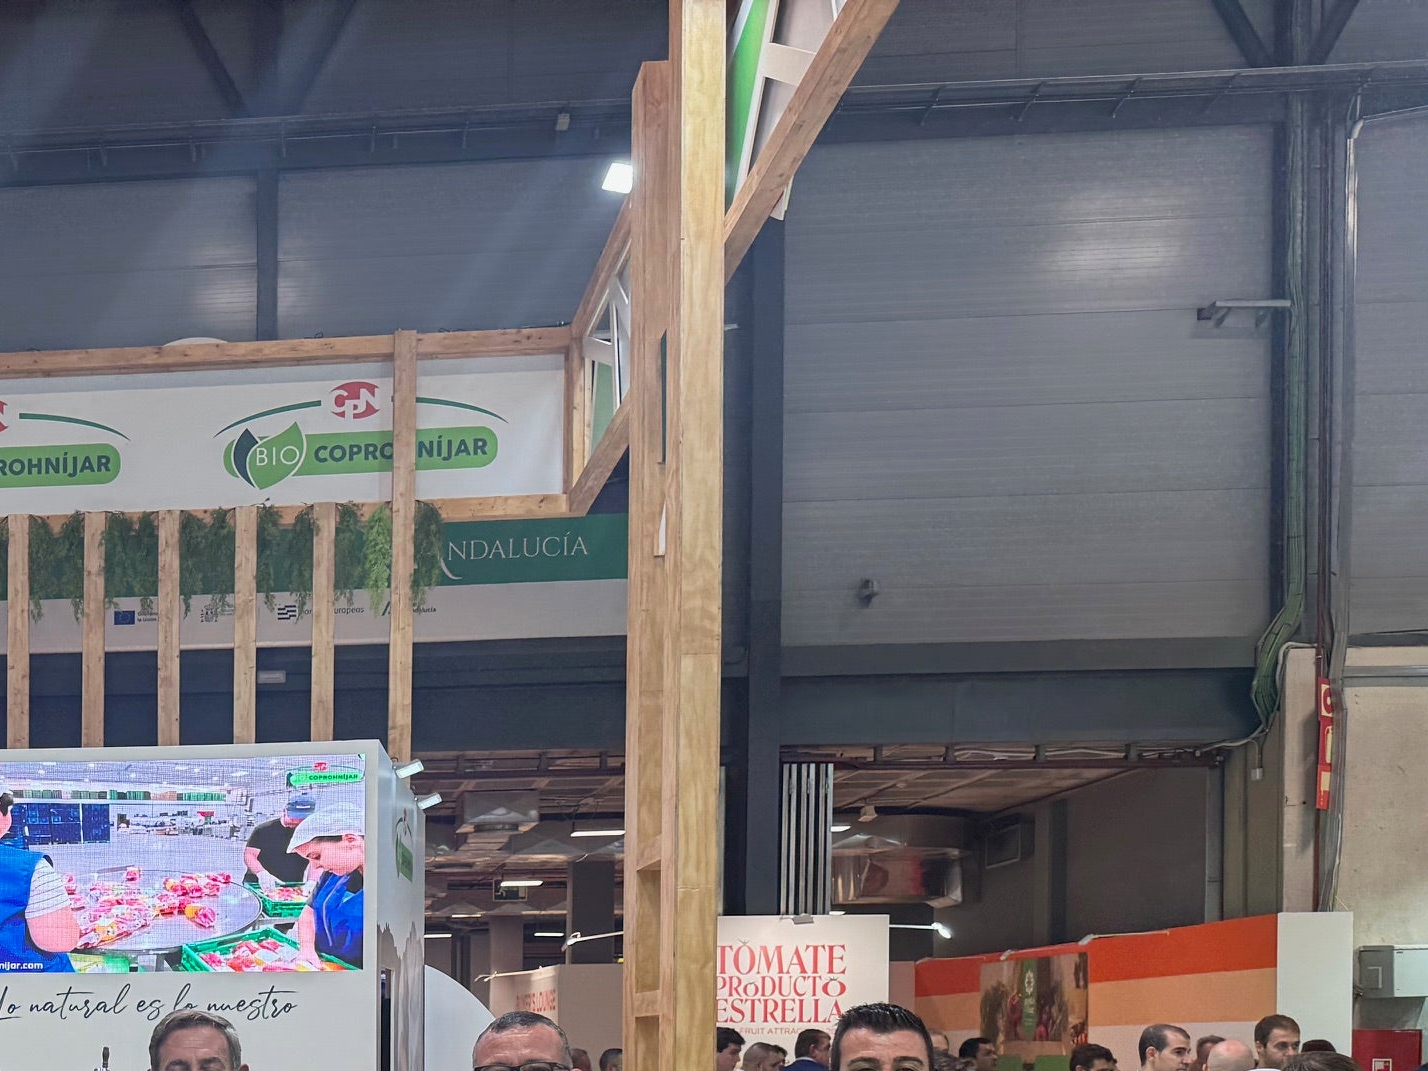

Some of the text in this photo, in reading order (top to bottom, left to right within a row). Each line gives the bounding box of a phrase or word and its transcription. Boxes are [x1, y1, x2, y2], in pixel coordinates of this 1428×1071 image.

[256, 435, 488, 466] BIO COPRONÍJAR
[441, 531, 588, 580] NDALUCÍA
[334, 607, 365, 615] uropeos
[717, 943, 847, 975] TOMATE
[28, 983, 132, 1021] natural
[136, 997, 167, 1022] es
[206, 985, 299, 1021] nuestro
[739, 1027, 765, 1035] FRUIT
